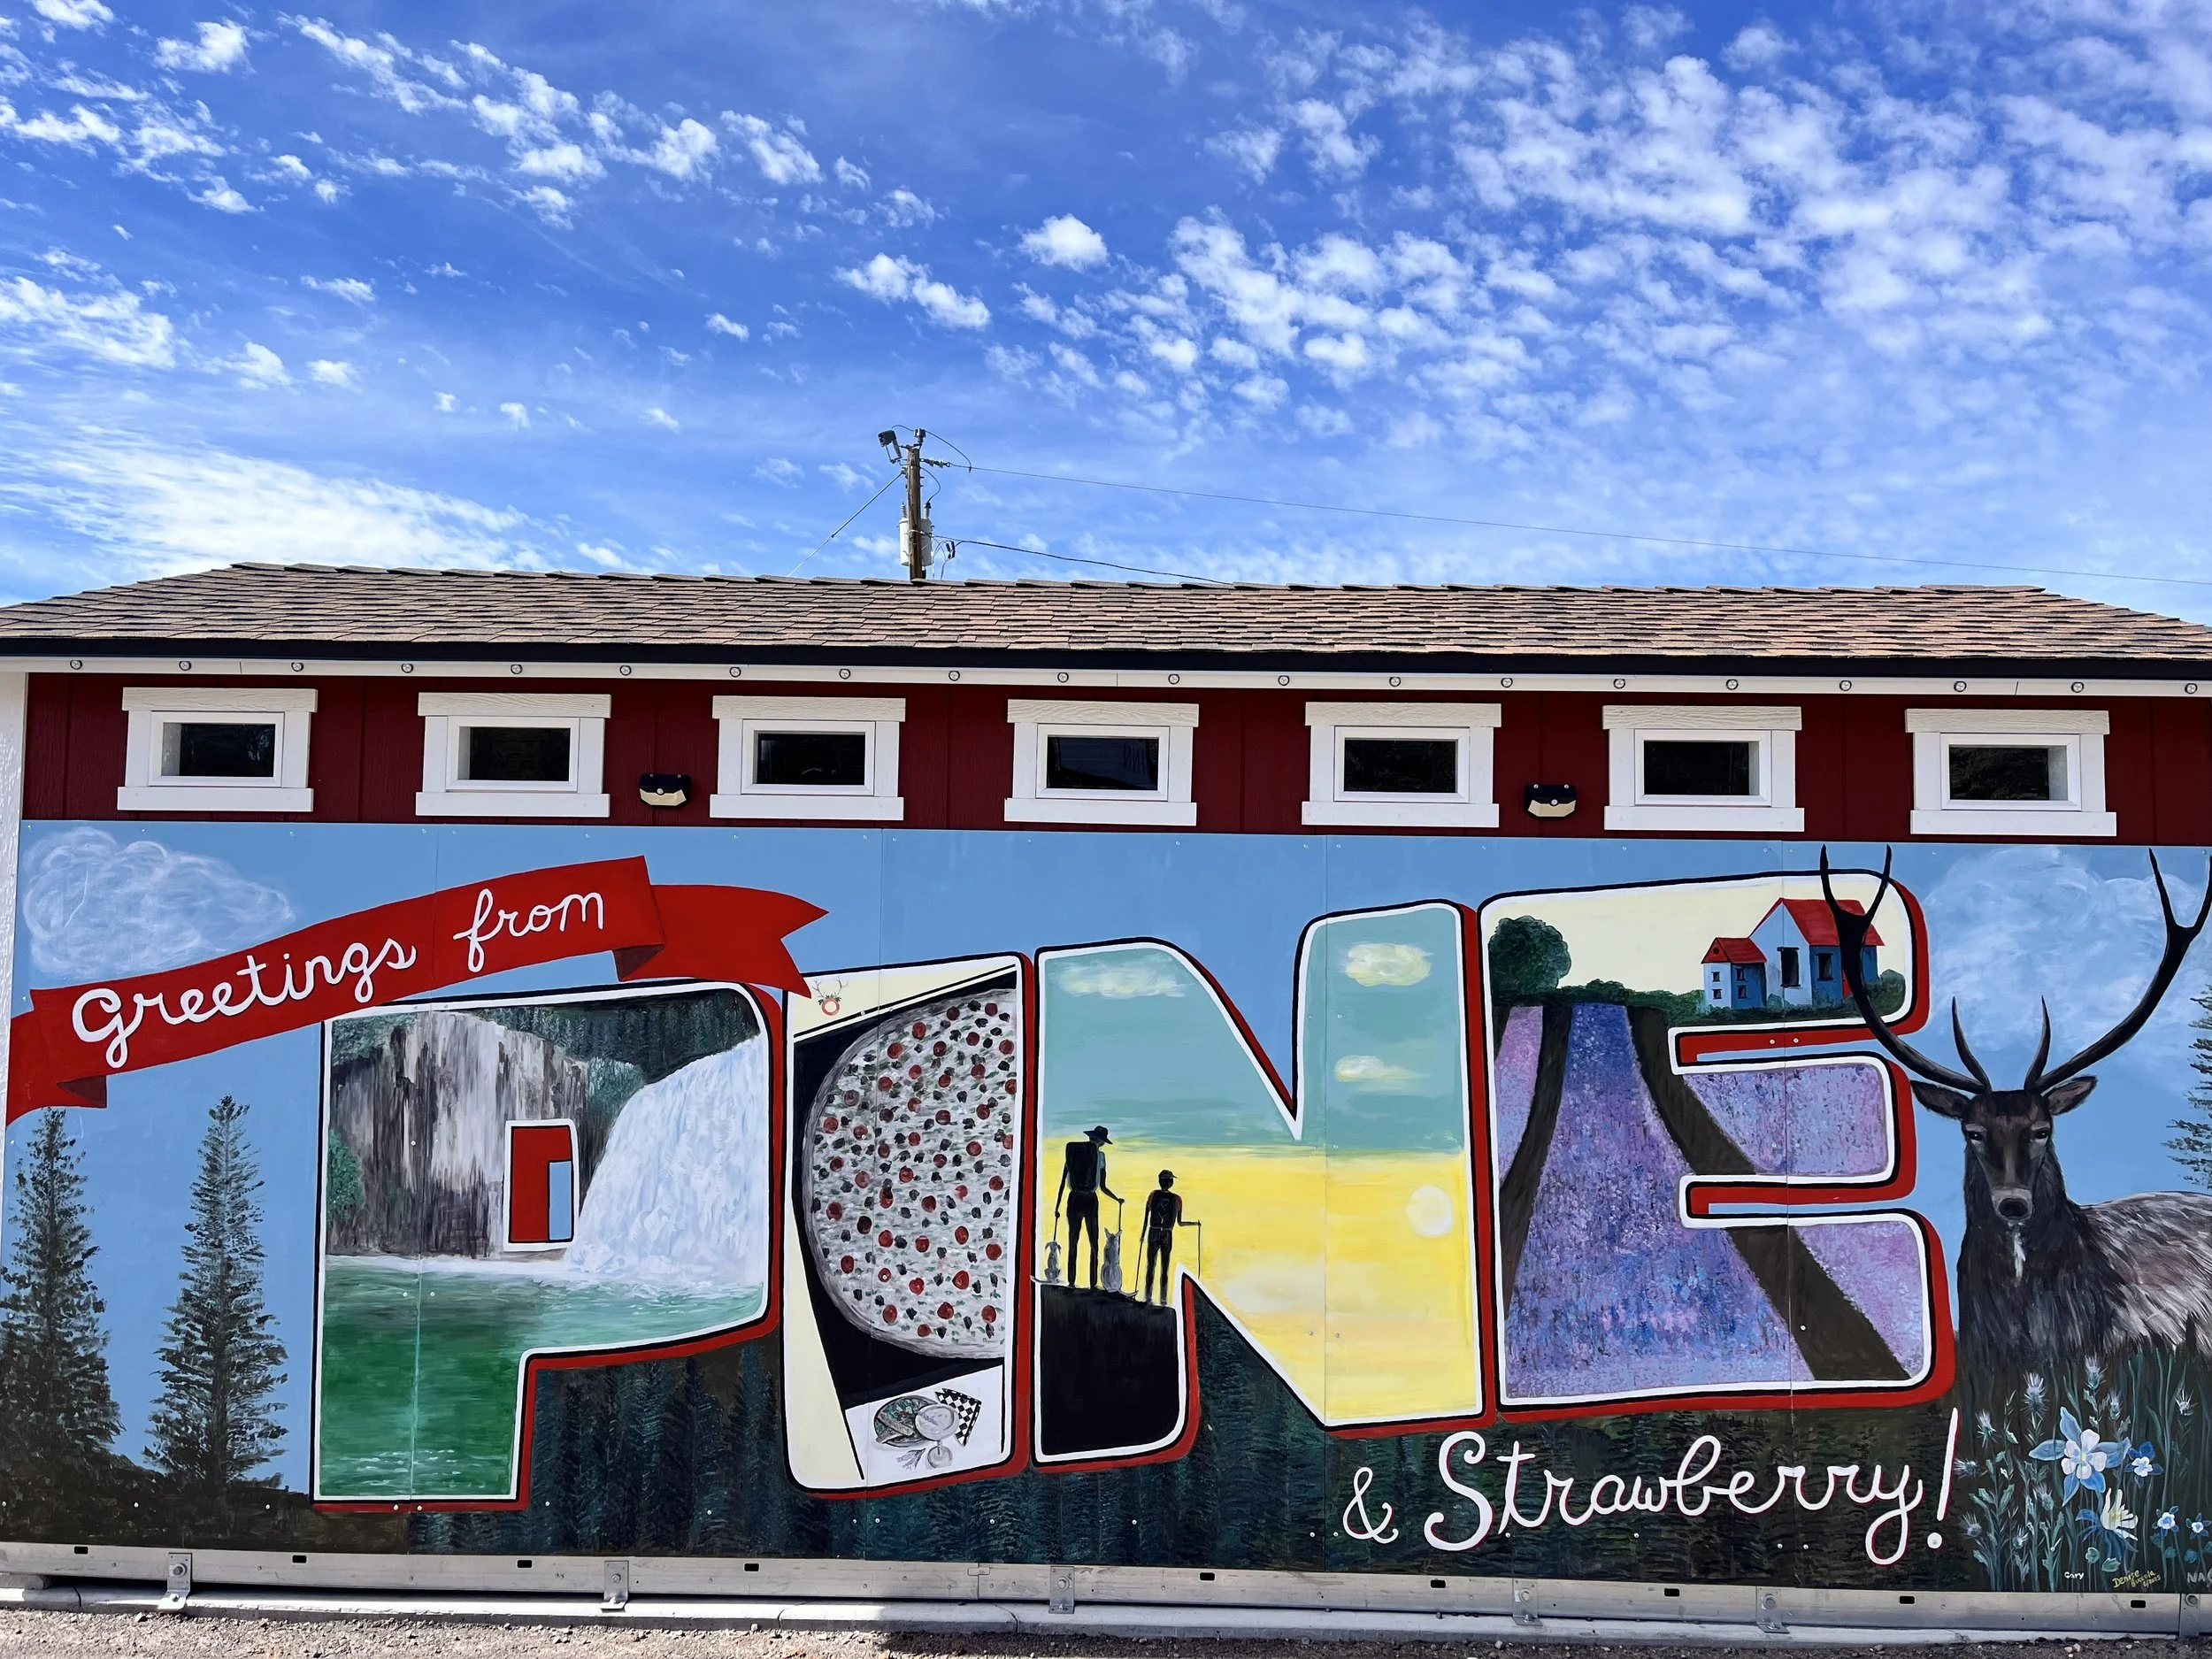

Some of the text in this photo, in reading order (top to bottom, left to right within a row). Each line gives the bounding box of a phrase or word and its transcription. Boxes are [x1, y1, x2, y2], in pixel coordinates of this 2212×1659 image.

[71, 887, 605, 1069] Greetings from
[311, 865, 1957, 1511] PINE
[1342, 1408, 1960, 1567] & Strawberry!
[2112, 1570, 2140, 1588] Denise
